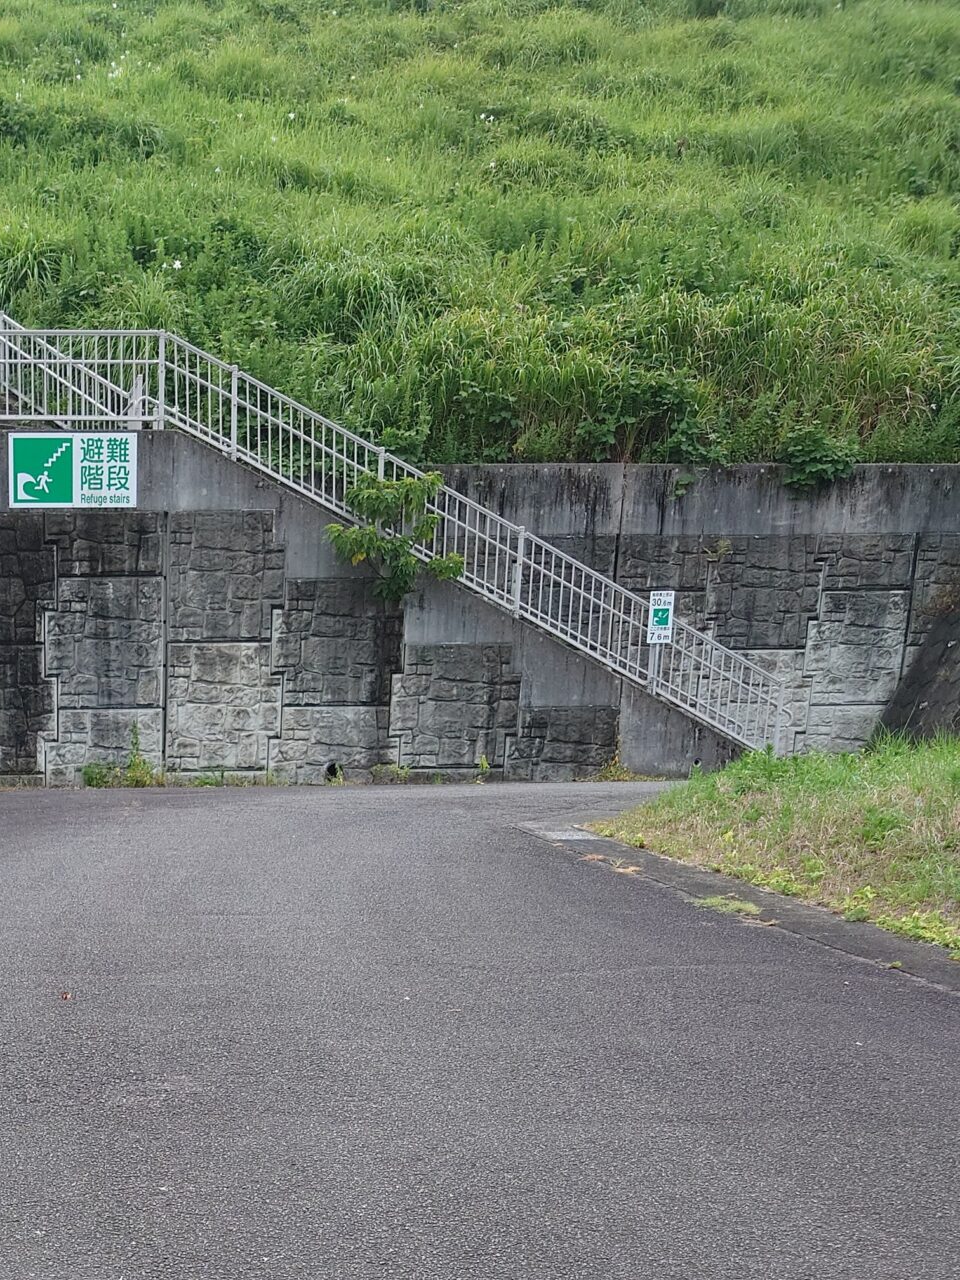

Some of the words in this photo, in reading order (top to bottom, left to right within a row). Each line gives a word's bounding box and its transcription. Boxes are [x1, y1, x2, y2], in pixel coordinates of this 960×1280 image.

[80, 437, 130, 463] 避難
[80, 465, 130, 491] 階段
[81, 494, 107, 506] Refuge
[109, 494, 130, 504] stairs
